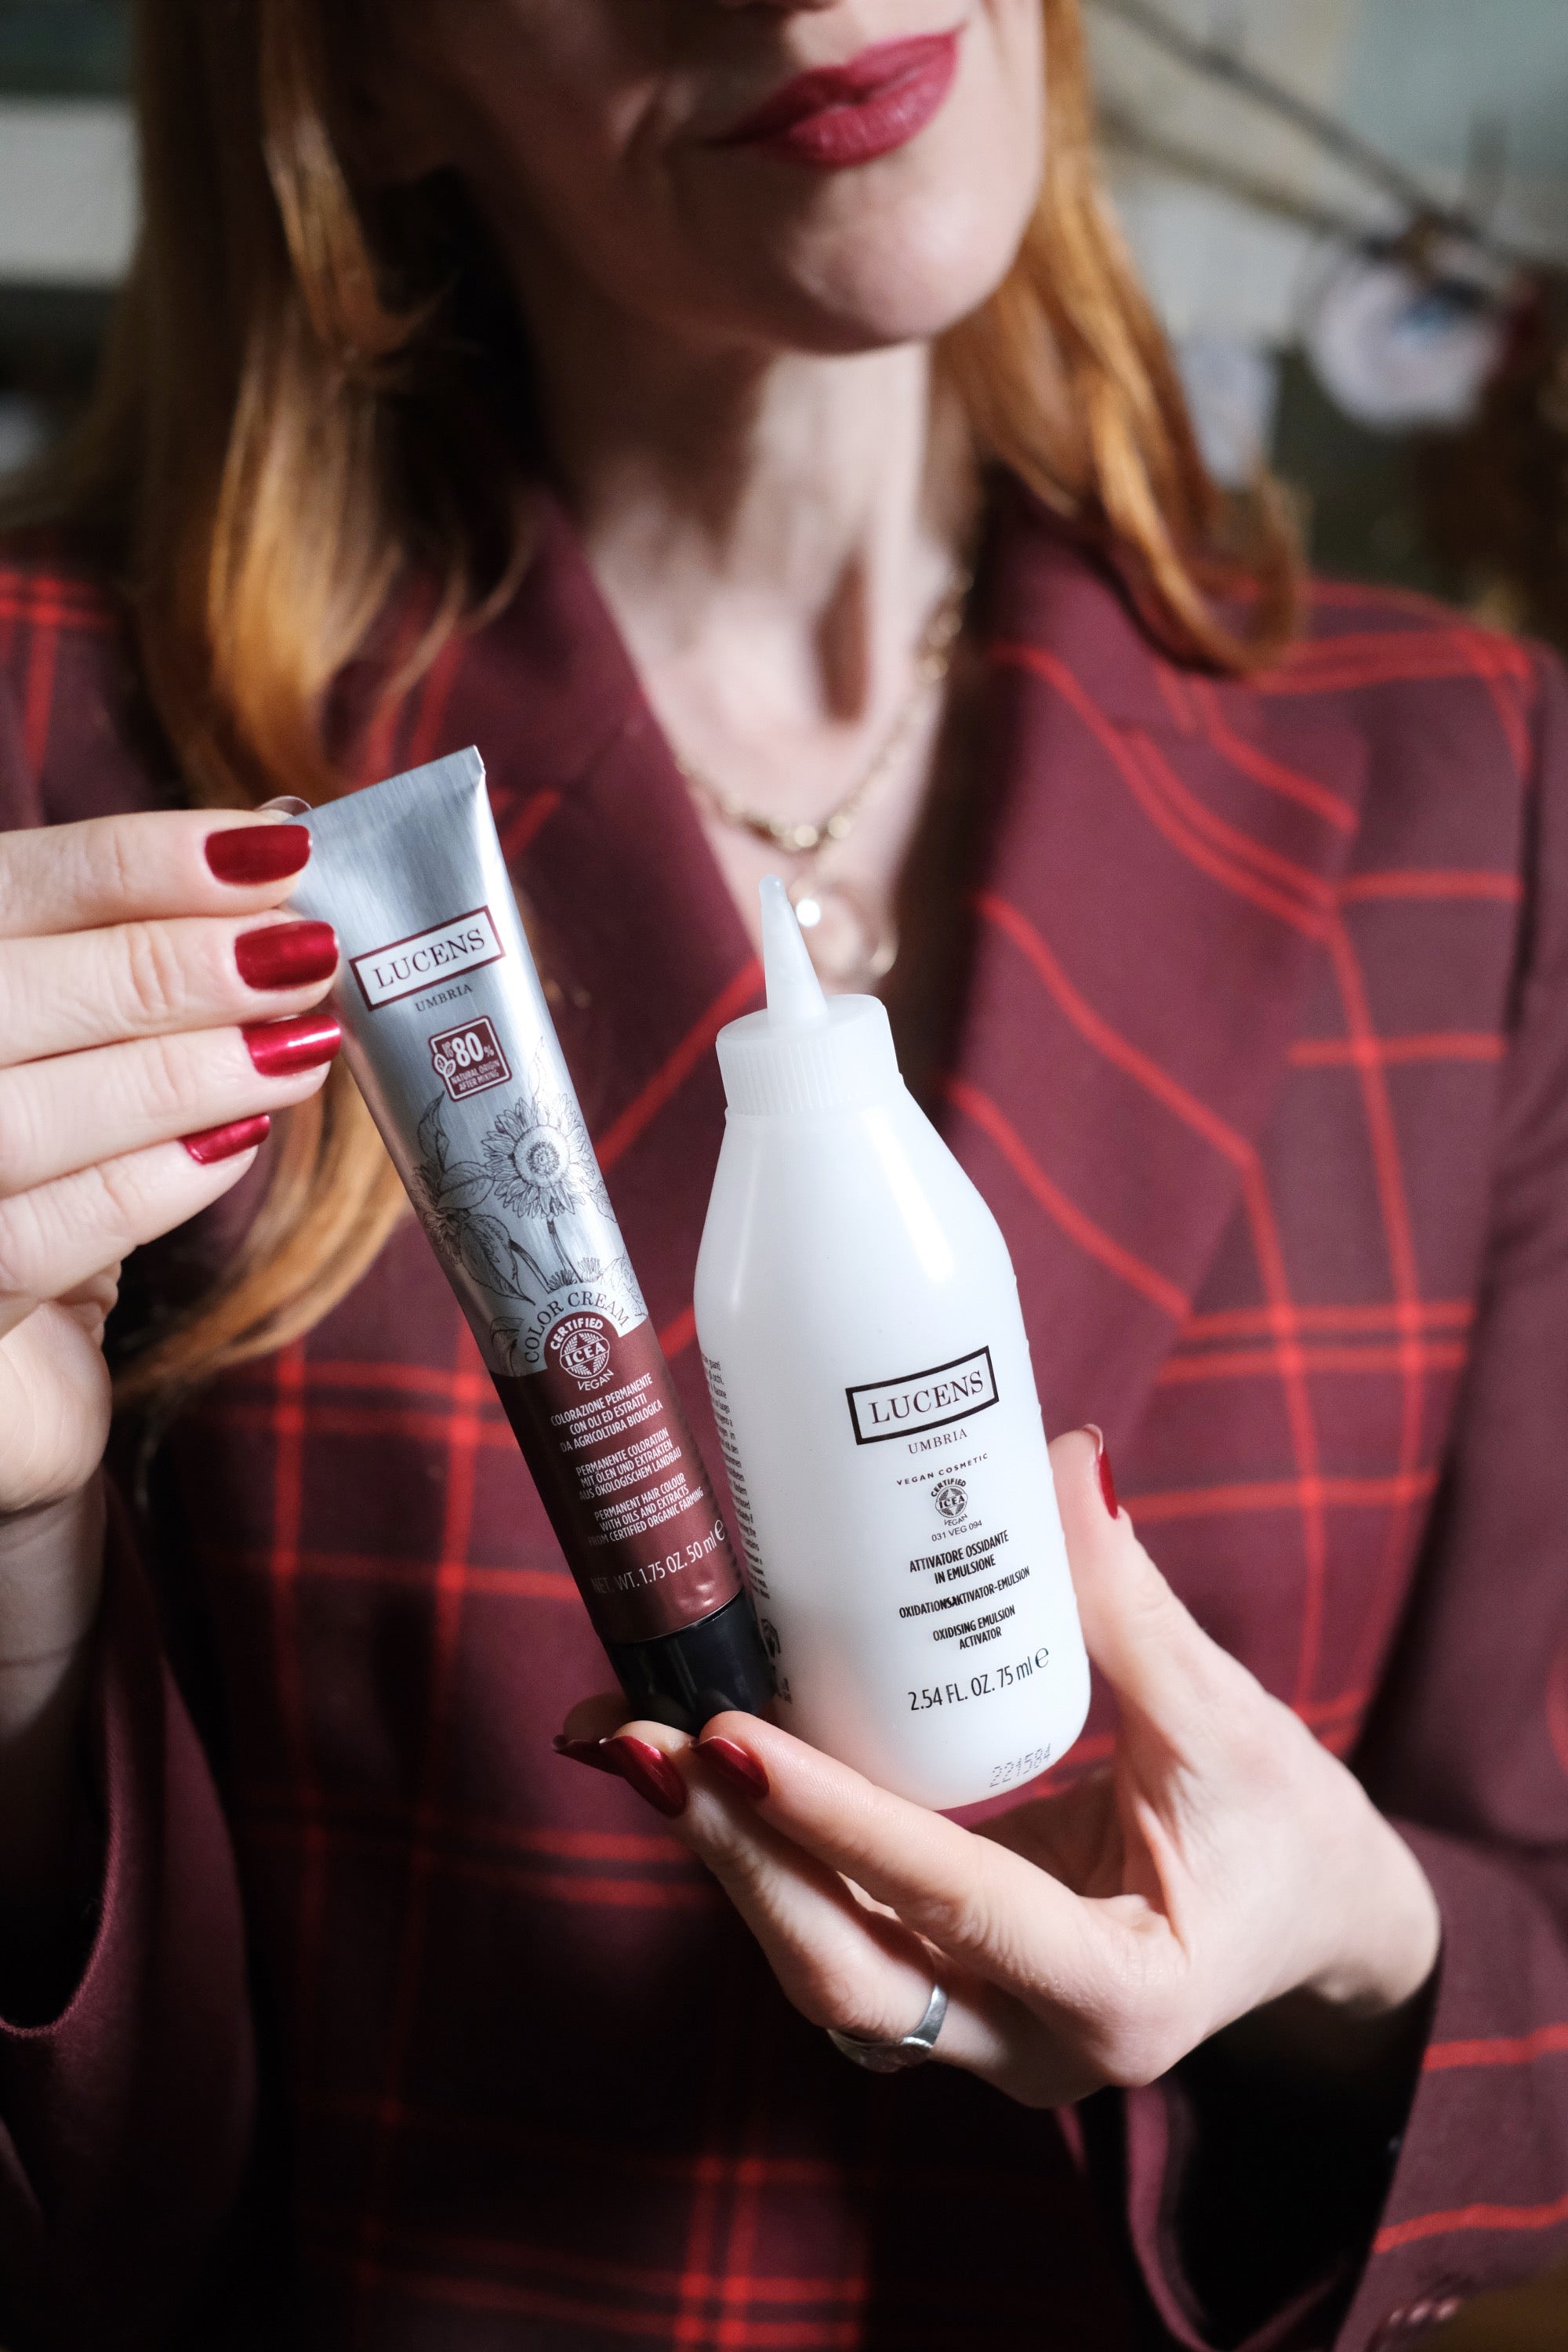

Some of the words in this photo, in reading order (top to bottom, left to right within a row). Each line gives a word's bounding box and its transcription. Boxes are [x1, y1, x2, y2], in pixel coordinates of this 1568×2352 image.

[372, 928, 485, 989] LUCENS
[415, 984, 473, 1012] UMBRIA
[524, 1300, 564, 1363] COLOR
[568, 1290, 630, 1327] CREAM
[550, 1317, 603, 1350] CERTIFIED
[564, 1342, 606, 1367] ICEA
[550, 1398, 606, 1426] COLORAZIONE
[604, 1373, 653, 1406] PERMANENTE
[577, 1369, 614, 1391] VEGAN
[868, 1370, 983, 1424] LUCENS
[560, 1441, 573, 1453] DA
[573, 1420, 627, 1450] AGRICOLTURA
[627, 1399, 663, 1427] BIOLOGICA
[569, 1422, 587, 1436] CON
[587, 1414, 602, 1428] OLI
[601, 1410, 613, 1423] ED
[613, 1393, 648, 1417] ESTRATTI
[575, 1450, 627, 1476] PERMANENTE
[627, 1427, 669, 1457] COLORATION
[908, 1428, 968, 1454] UMBRIA
[579, 1490, 595, 1501] AUS
[595, 1465, 652, 1497] ÖKOLOGISCHEM
[652, 1446, 682, 1472] LANDBAU
[580, 1476, 595, 1489] MIT
[596, 1469, 616, 1483] ÖLEN
[616, 1462, 635, 1475] UND
[635, 1439, 673, 1467] EXTRAKTEN
[897, 1472, 935, 1486] VEGAN
[938, 1453, 988, 1475] COSMETIC
[594, 1496, 641, 1521] PERMANENT
[641, 1488, 660, 1504] HAIR
[660, 1472, 686, 1494] COLOUR
[599, 1517, 623, 1532] WITH
[622, 1510, 641, 1526] OILS
[641, 1503, 657, 1519] AND
[657, 1483, 689, 1510] EXTRACTS
[931, 1478, 967, 1497] CERTIFIED
[939, 1495, 965, 1509] ICEA
[609, 1520, 647, 1542] CERTIFIED
[647, 1503, 680, 1527] ORGANIC
[679, 1486, 704, 1512] FARMING
[931, 1531, 946, 1542] 031
[948, 1525, 967, 1536] VEG
[968, 1519, 982, 1530] 094
[944, 1513, 968, 1526] VEGAN
[614, 1571, 641, 1592] WT.
[639, 1561, 666, 1584] 1.75
[666, 1552, 688, 1573] OZ.
[686, 1541, 703, 1563] 50
[703, 1530, 717, 1554] ml
[909, 1548, 964, 1573] ATTIVATORE
[965, 1530, 1009, 1558] OSSIDANTE
[934, 1572, 946, 1584] IN
[947, 1554, 996, 1581] EMULSIONE
[932, 1620, 977, 1642] OXIDISING
[978, 1605, 1016, 1629] EMULSION
[959, 1626, 1002, 1650] ACTIVATOR
[908, 1686, 943, 1711] 2.54
[946, 1683, 968, 1704] FL.
[971, 1674, 996, 1697] OZ.
[996, 1665, 1014, 1688] 75
[1016, 1656, 1033, 1680] ml
